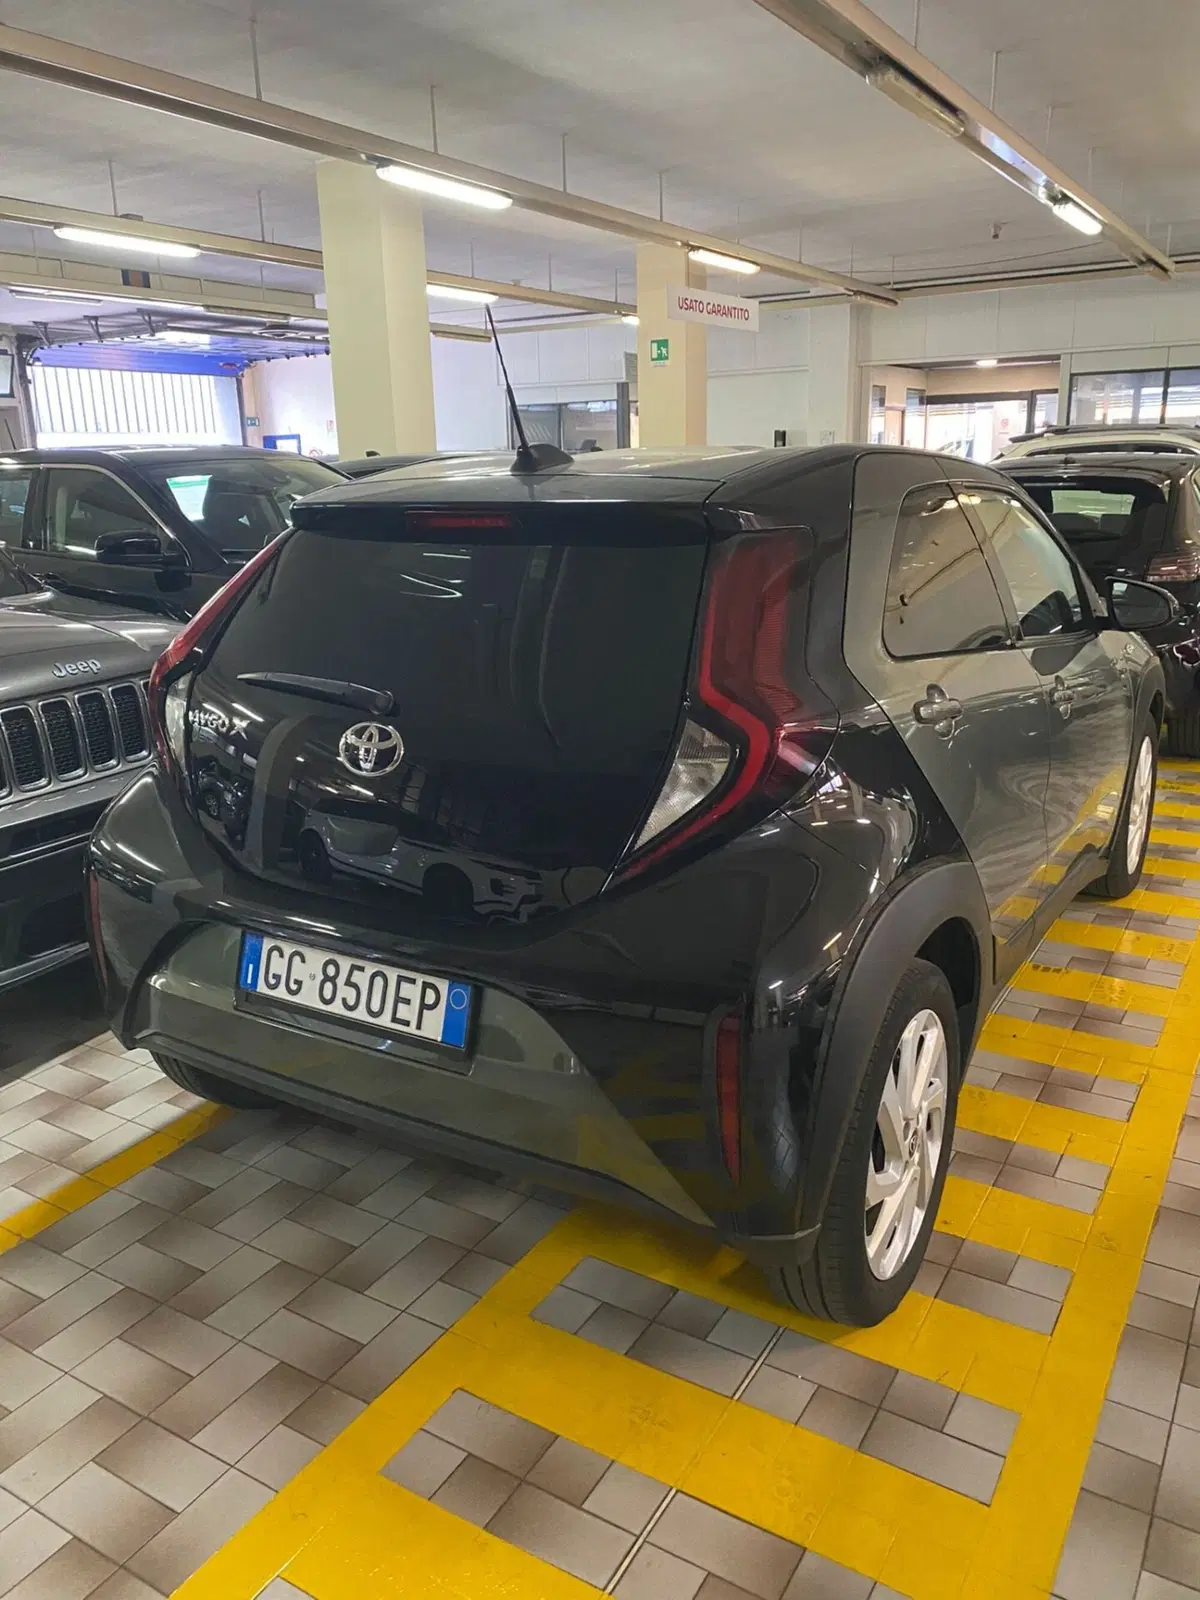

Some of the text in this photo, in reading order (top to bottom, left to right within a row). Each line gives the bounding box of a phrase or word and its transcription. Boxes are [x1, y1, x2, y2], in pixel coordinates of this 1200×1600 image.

[677, 296, 750, 321] USATO GARANTITO
[52, 659, 101, 678] Jeep
[263, 944, 441, 1031] GG 850EP
